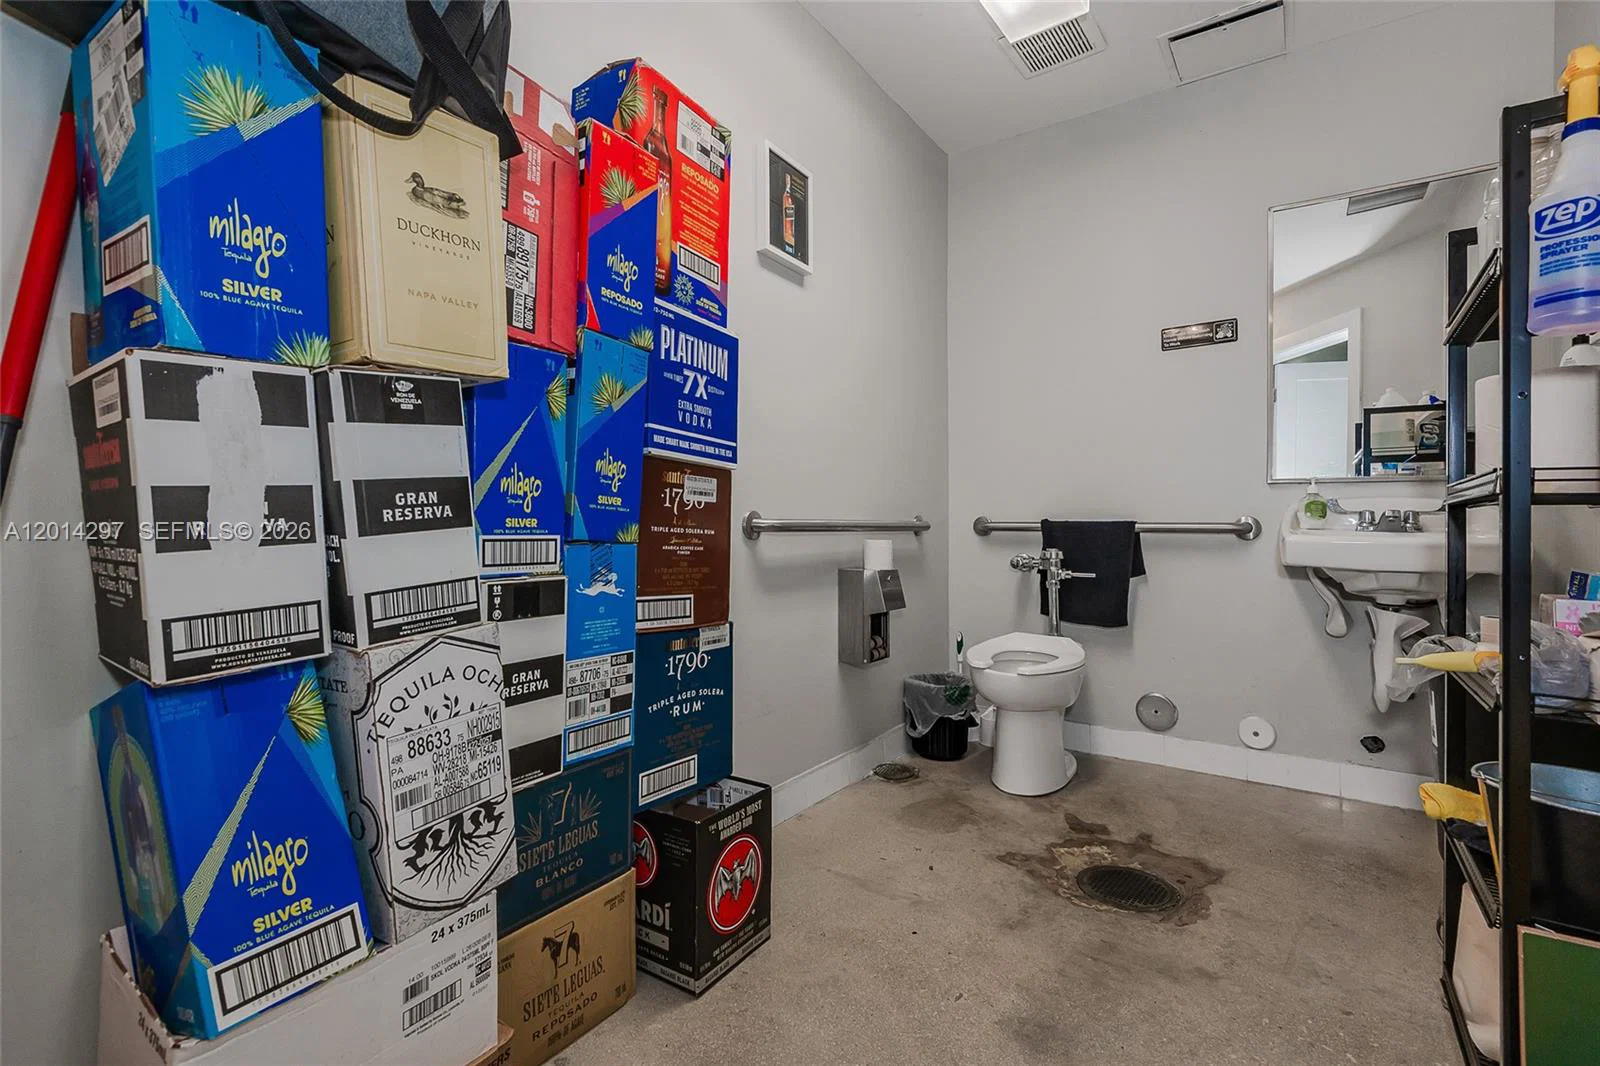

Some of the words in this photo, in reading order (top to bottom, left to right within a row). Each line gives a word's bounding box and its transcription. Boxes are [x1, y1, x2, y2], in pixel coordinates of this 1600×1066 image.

[682, 162, 720, 194] REPOSADO
[209, 197, 286, 278] milagro
[396, 217, 481, 251] DUCKHORN
[516, 246, 530, 282] 89175
[1540, 244, 1588, 260] SPRAYER
[607, 244, 638, 292] milagro
[200, 290, 220, 300] 100%
[223, 296, 242, 304] BLUE
[244, 299, 270, 310] AGAVE
[272, 304, 304, 315] TEQUILA
[222, 278, 282, 302] SILVER
[408, 288, 437, 302] NAPA
[442, 296, 479, 310] VALLEY
[601, 286, 643, 310] REPOSADO
[660, 324, 728, 382] PLATINUM
[682, 368, 708, 400] 7X
[678, 400, 692, 412] EXTRA
[678, 411, 712, 430] VODKA
[596, 448, 627, 492] milagro
[395, 491, 438, 505] GRAN
[500, 462, 542, 513] milagro
[598, 495, 622, 506] SILVER
[382, 504, 453, 522] RESERVA
[506, 518, 538, 528] SILVER
[333, 630, 355, 644] PROOF
[215, 654, 246, 663] PRODUCTO
[256, 648, 286, 656] VENEZUELA
[667, 651, 708, 680] 1796
[502, 678, 550, 700] RESERVA
[512, 668, 541, 684] GRAN
[580, 668, 601, 683] 87706
[367, 666, 455, 743] TEQUILA
[462, 665, 507, 701] OCH
[648, 696, 674, 714] TRIPLE
[677, 689, 697, 700] AGED
[698, 688, 724, 696] SOLERA
[673, 700, 702, 718] RUM
[408, 728, 452, 758] 88633
[391, 766, 404, 777] PA
[718, 808, 746, 831] WORLD'S
[746, 800, 762, 816] MOST
[519, 840, 556, 873] SIETE
[558, 820, 598, 855] LEGUAS
[232, 830, 309, 896] milagro
[536, 858, 584, 888] BLANCO
[234, 940, 254, 953] 100%
[256, 931, 276, 944] BLUE
[278, 918, 303, 934] AGAVE
[305, 904, 335, 922] TEQUILA
[253, 898, 314, 934] SILVER
[431, 928, 445, 944] 24
[448, 924, 454, 934] x
[457, 903, 492, 930] 375mL
[522, 984, 560, 1023] SIETE
[532, 991, 598, 1042] REPOSADO
